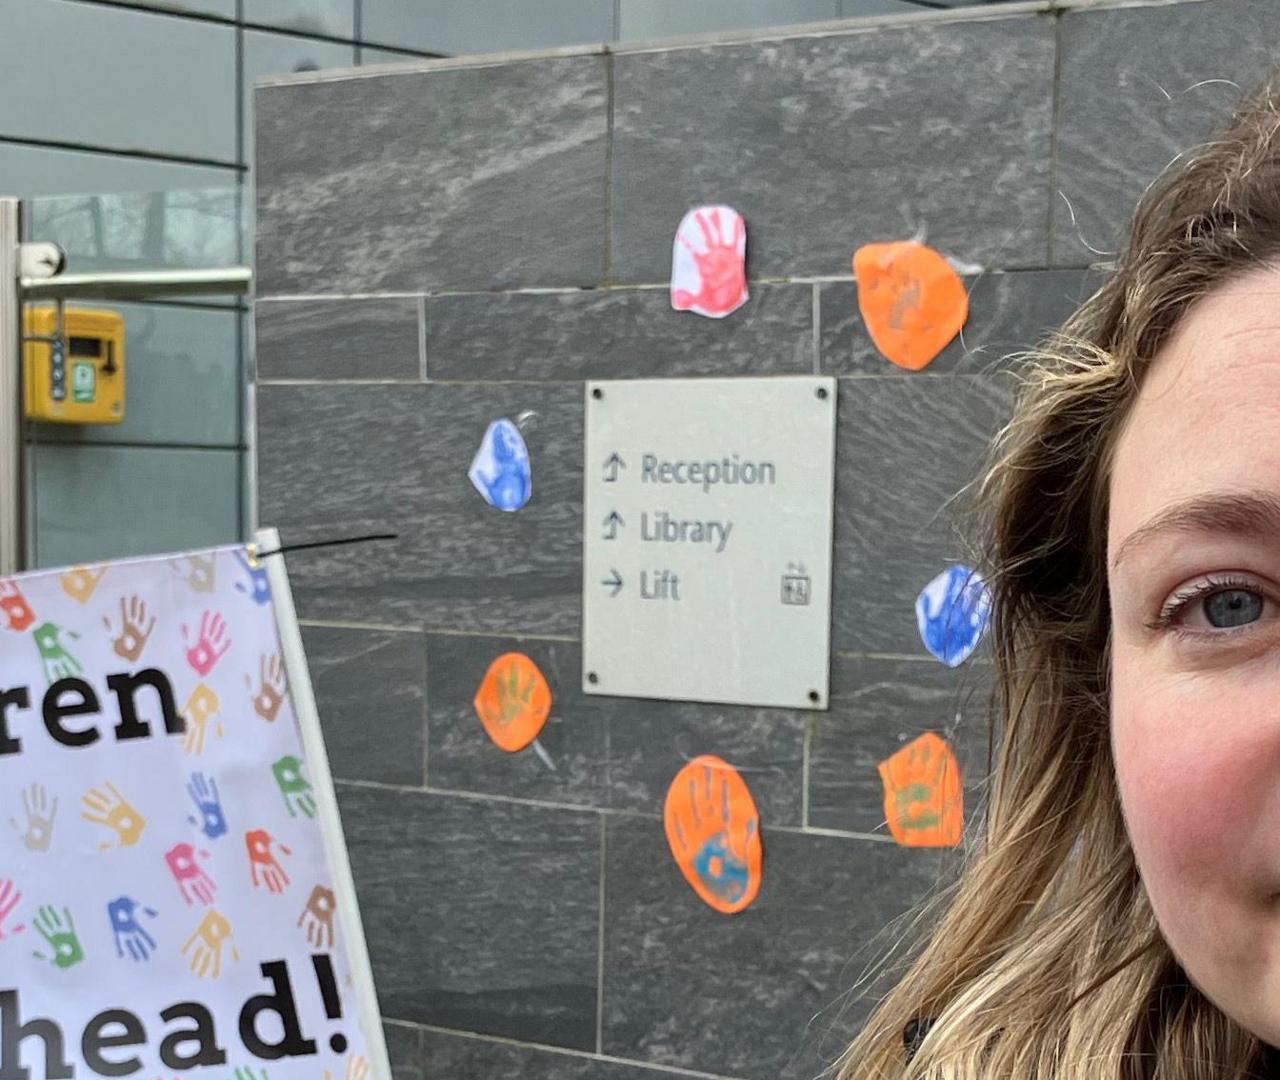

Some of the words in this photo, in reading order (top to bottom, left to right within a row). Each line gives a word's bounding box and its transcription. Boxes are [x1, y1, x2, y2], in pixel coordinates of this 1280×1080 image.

[641, 454, 776, 492] Reception
[640, 512, 733, 553] Library
[638, 568, 681, 602] Lift
